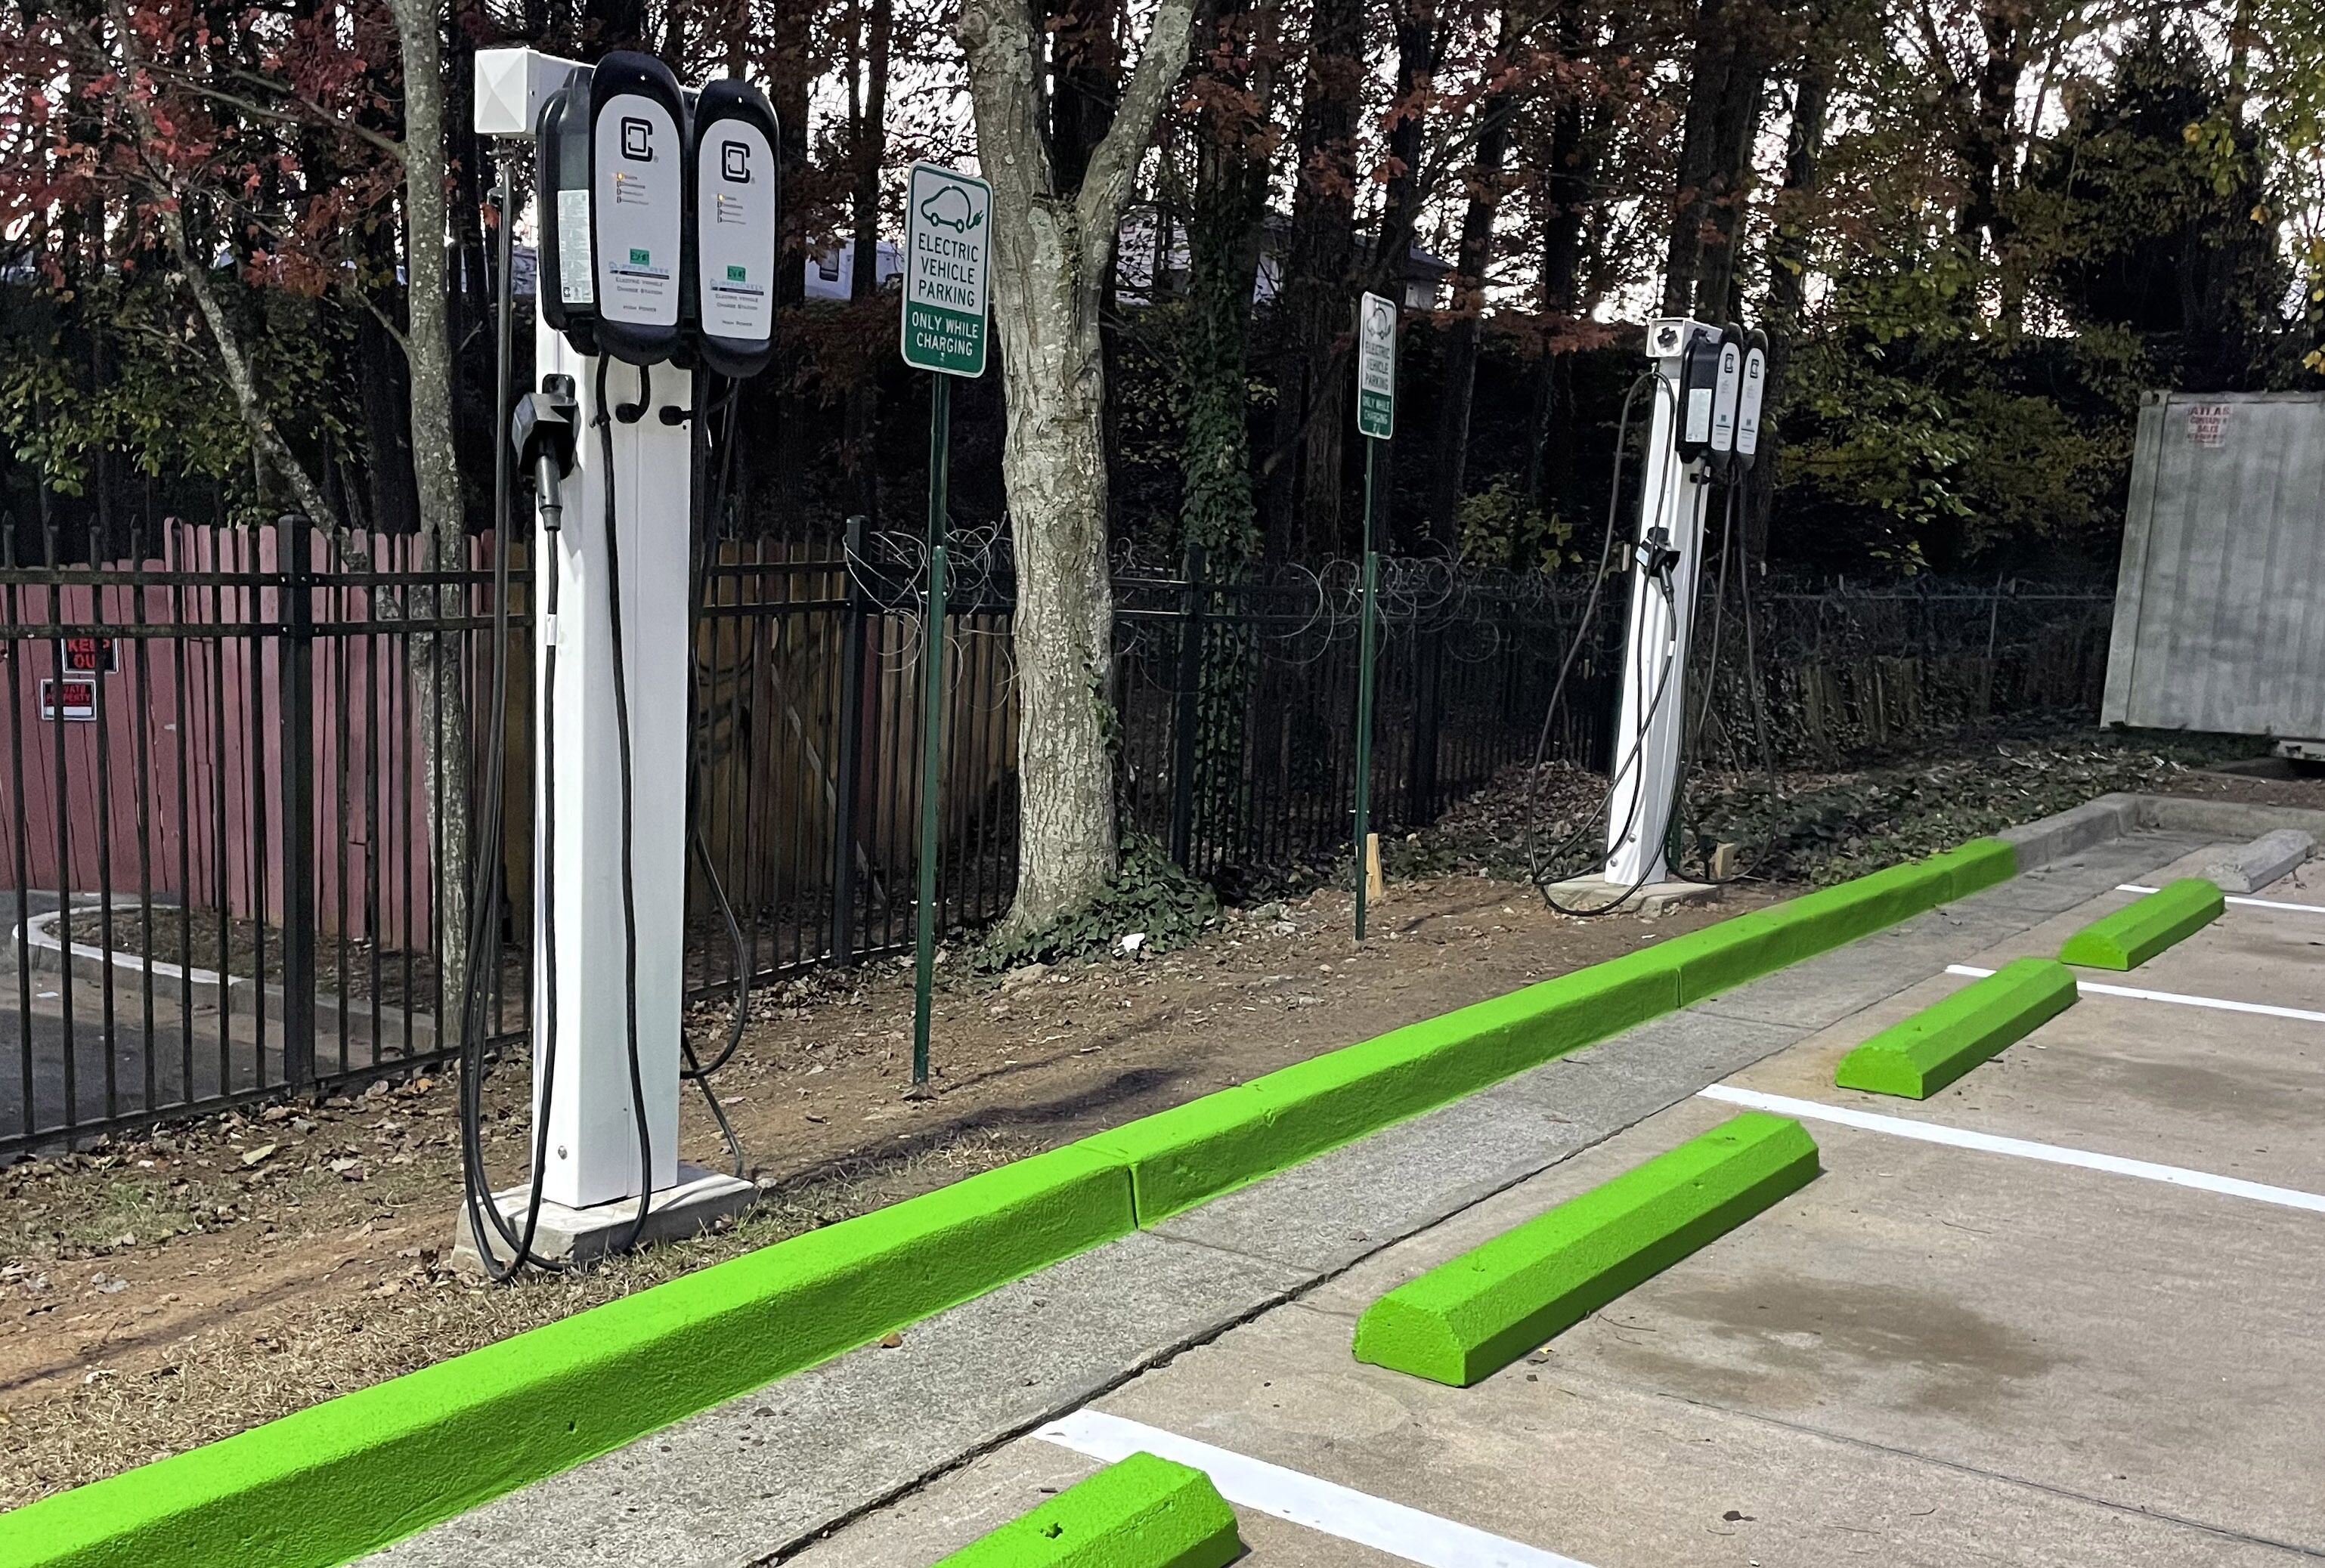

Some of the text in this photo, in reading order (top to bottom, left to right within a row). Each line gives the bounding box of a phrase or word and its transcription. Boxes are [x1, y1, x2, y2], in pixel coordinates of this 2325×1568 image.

[919, 233, 979, 263] ELECTRIC
[921, 256, 975, 285] VEHICLE
[918, 280, 975, 308] PARKING
[912, 311, 979, 339] ONLY WHILE
[916, 332, 974, 357] CHARGING
[1365, 341, 1391, 360] ELECTRIC
[1366, 357, 1388, 375] VEHICLE
[1365, 373, 1388, 391] PARKING
[1363, 395, 1390, 413] ONLY WHILE
[1364, 409, 1388, 425] CHARGING
[73, 653, 97, 670] OU
